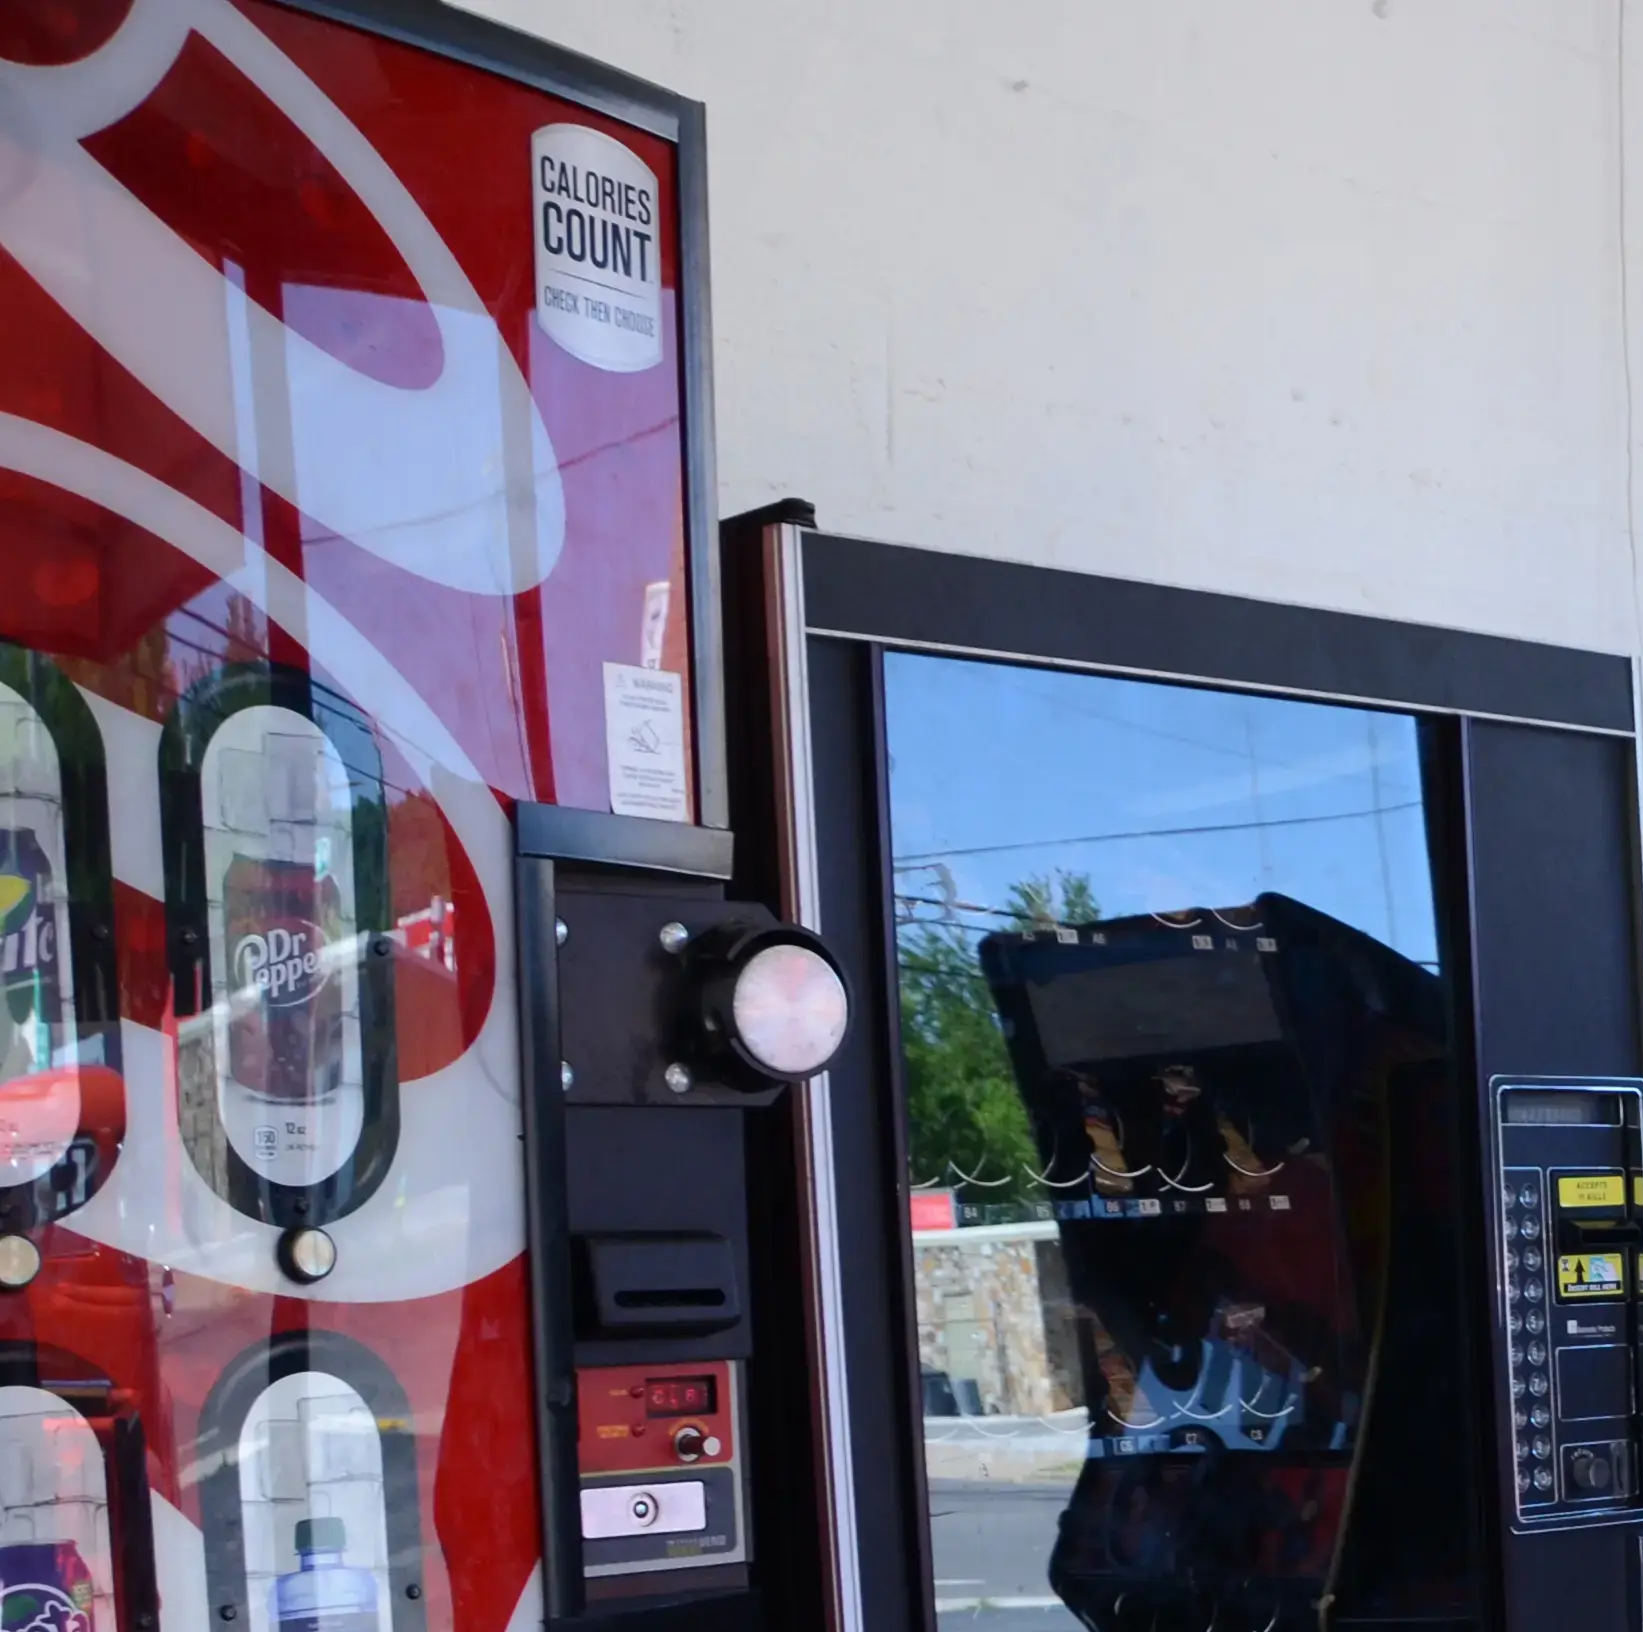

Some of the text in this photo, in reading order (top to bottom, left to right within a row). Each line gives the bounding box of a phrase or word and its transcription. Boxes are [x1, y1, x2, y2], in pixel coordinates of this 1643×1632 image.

[540, 155, 651, 226] CALORIES
[543, 201, 651, 282] COUNT
[544, 285, 655, 338] CHECK THEN CHOOSE
[234, 934, 322, 998] Peppe
[267, 928, 307, 964] Dr
